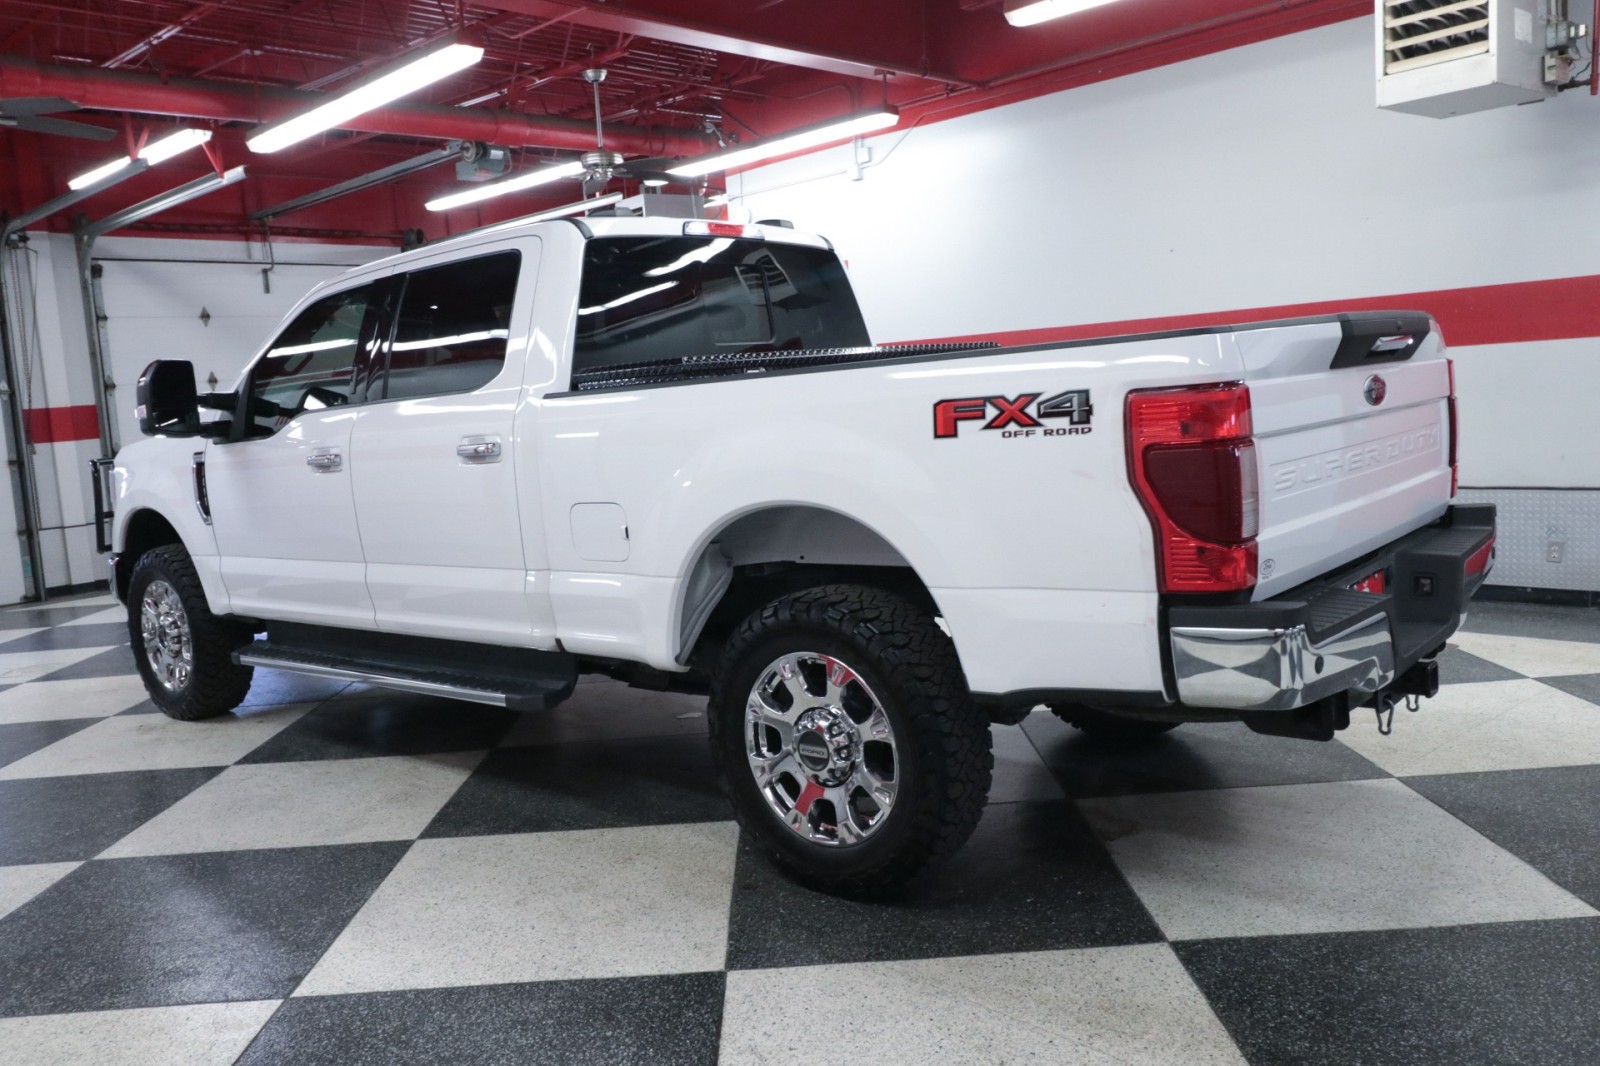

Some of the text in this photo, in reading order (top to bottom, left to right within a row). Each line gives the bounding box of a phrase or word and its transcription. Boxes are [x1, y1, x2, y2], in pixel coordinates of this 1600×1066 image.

[933, 388, 1093, 439] FX4
[1001, 426, 1092, 439] OFF ROAD
[1273, 424, 1440, 492] SUPER DUTY
[801, 747, 825, 756] FORD
